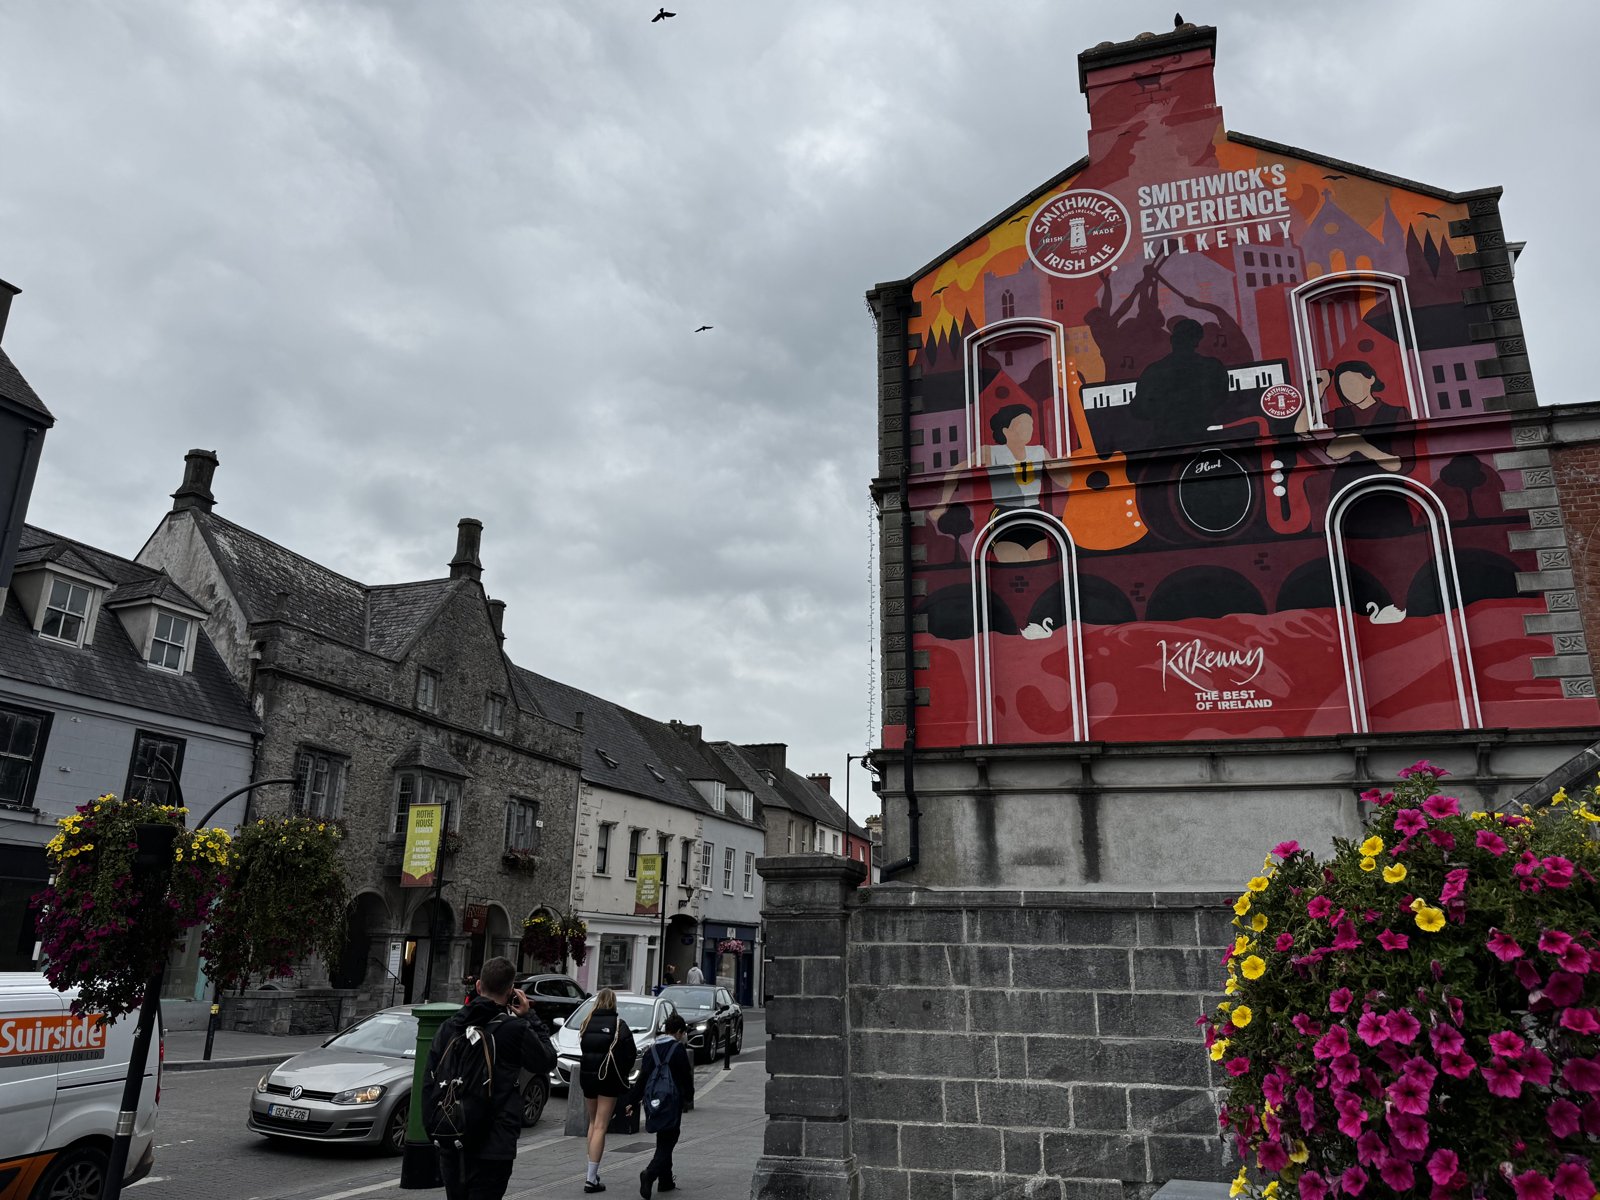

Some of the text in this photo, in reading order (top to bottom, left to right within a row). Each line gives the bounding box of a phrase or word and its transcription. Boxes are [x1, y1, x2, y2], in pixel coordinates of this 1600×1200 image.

[1138, 164, 1286, 207] SMITHWICK'S
[1140, 187, 1290, 233] EXPERIENCE
[1042, 227, 1114, 244] IRISH MADE
[1143, 220, 1291, 259] KILKENNY
[1043, 244, 1115, 271] IRISH ALE
[1268, 405, 1297, 416] IRISH ALE
[1157, 639, 1264, 692] Kilkenny
[1195, 690, 1255, 701] THE BEST
[1196, 699, 1273, 711] OF IRELAND
[415, 818, 434, 827] HOUSE
[416, 810, 434, 818] ROTHE
[0, 1016, 103, 1054] Suirside
[21, 1052, 83, 1065] CONSTRUCTION
